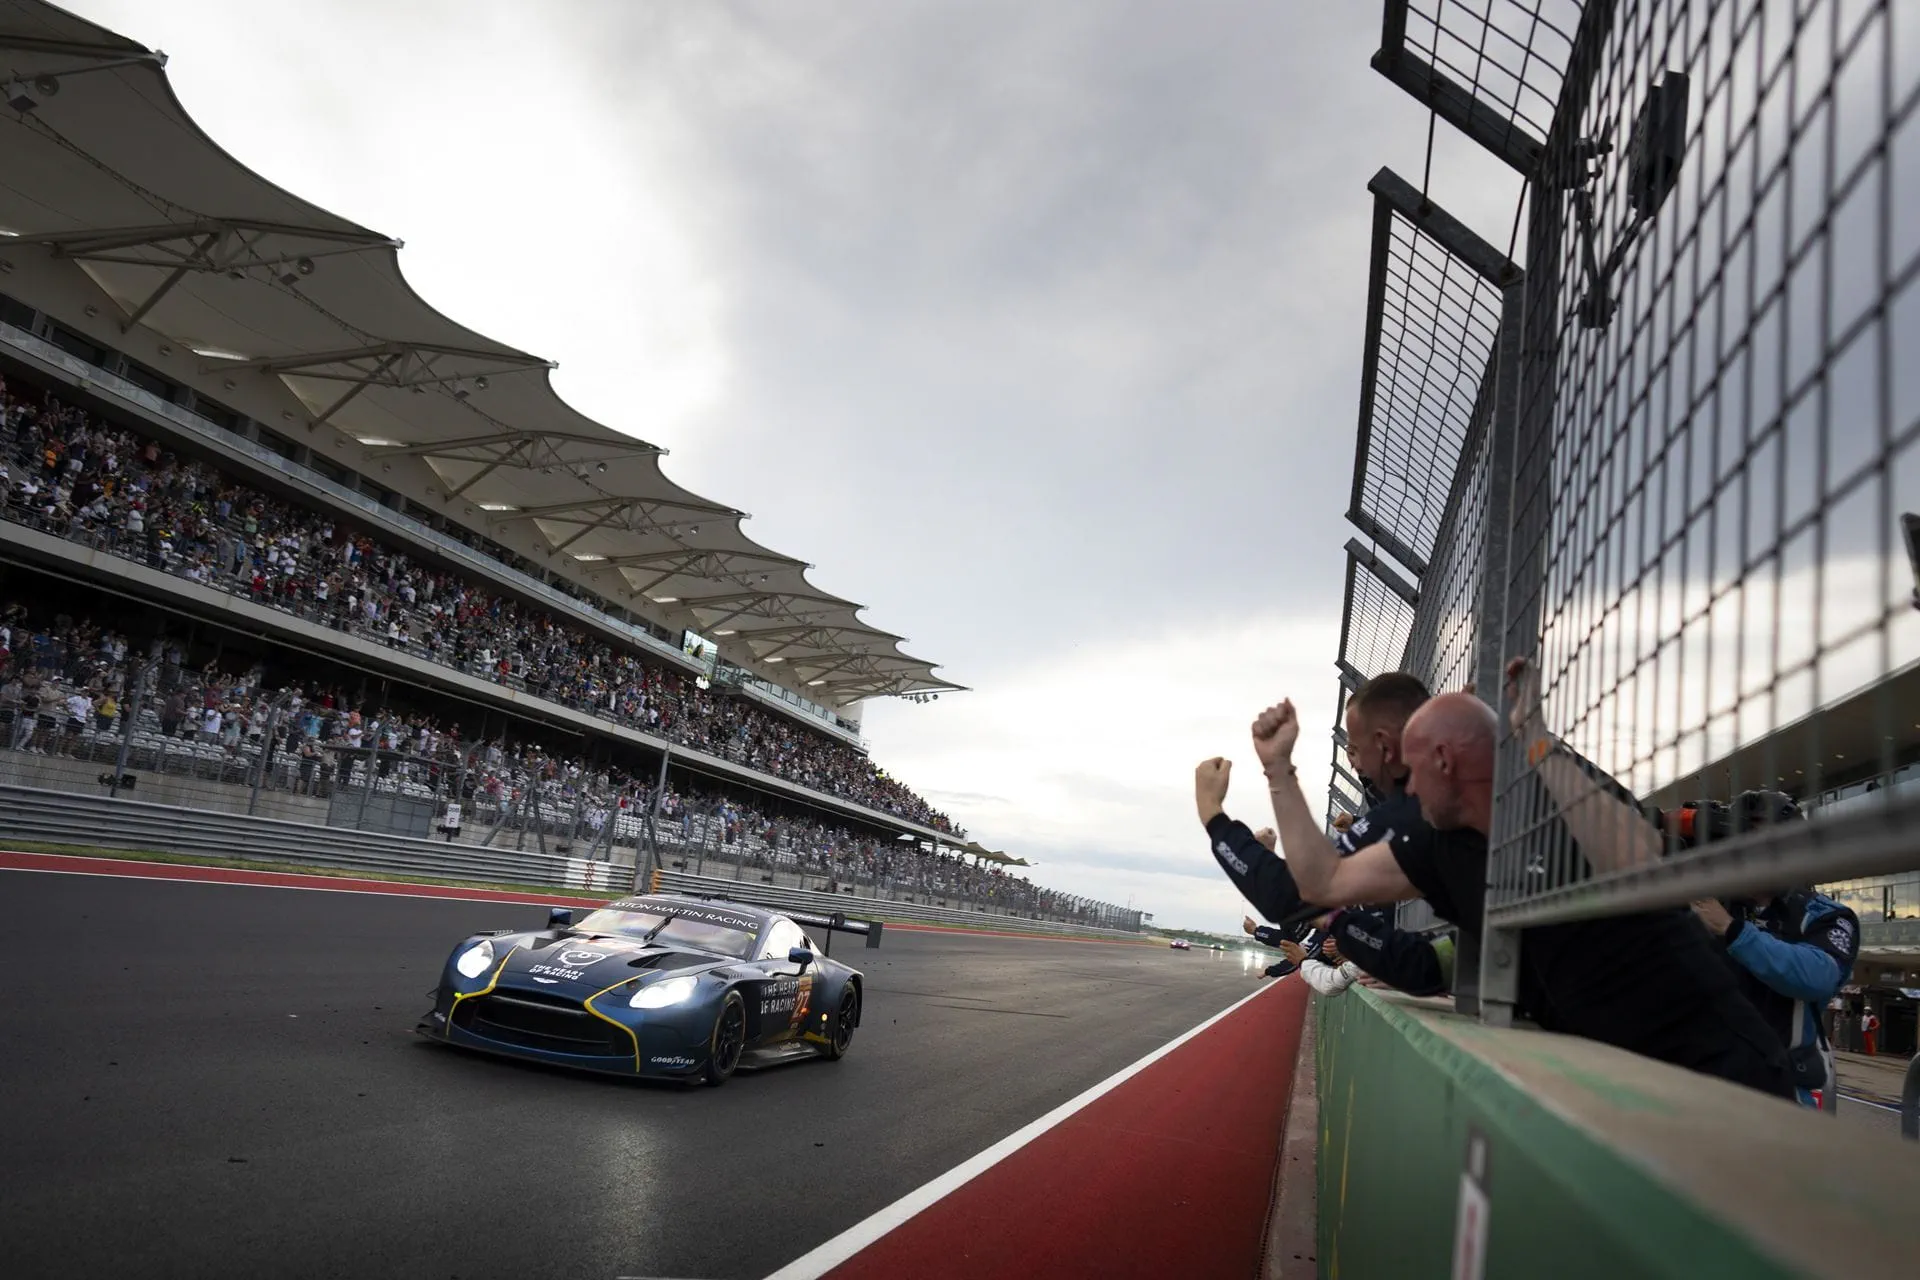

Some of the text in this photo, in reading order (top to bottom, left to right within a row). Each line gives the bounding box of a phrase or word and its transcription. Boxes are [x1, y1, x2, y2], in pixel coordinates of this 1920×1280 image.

[610, 901, 651, 910] ASTON
[705, 913, 759, 930] RACING
[542, 970, 580, 980] RACING
[552, 967, 584, 976] HEART
[763, 983, 777, 997] THE
[770, 998, 796, 1014] RACING
[792, 990, 810, 1018] 27
[650, 1056, 696, 1065] GOODYEAR
